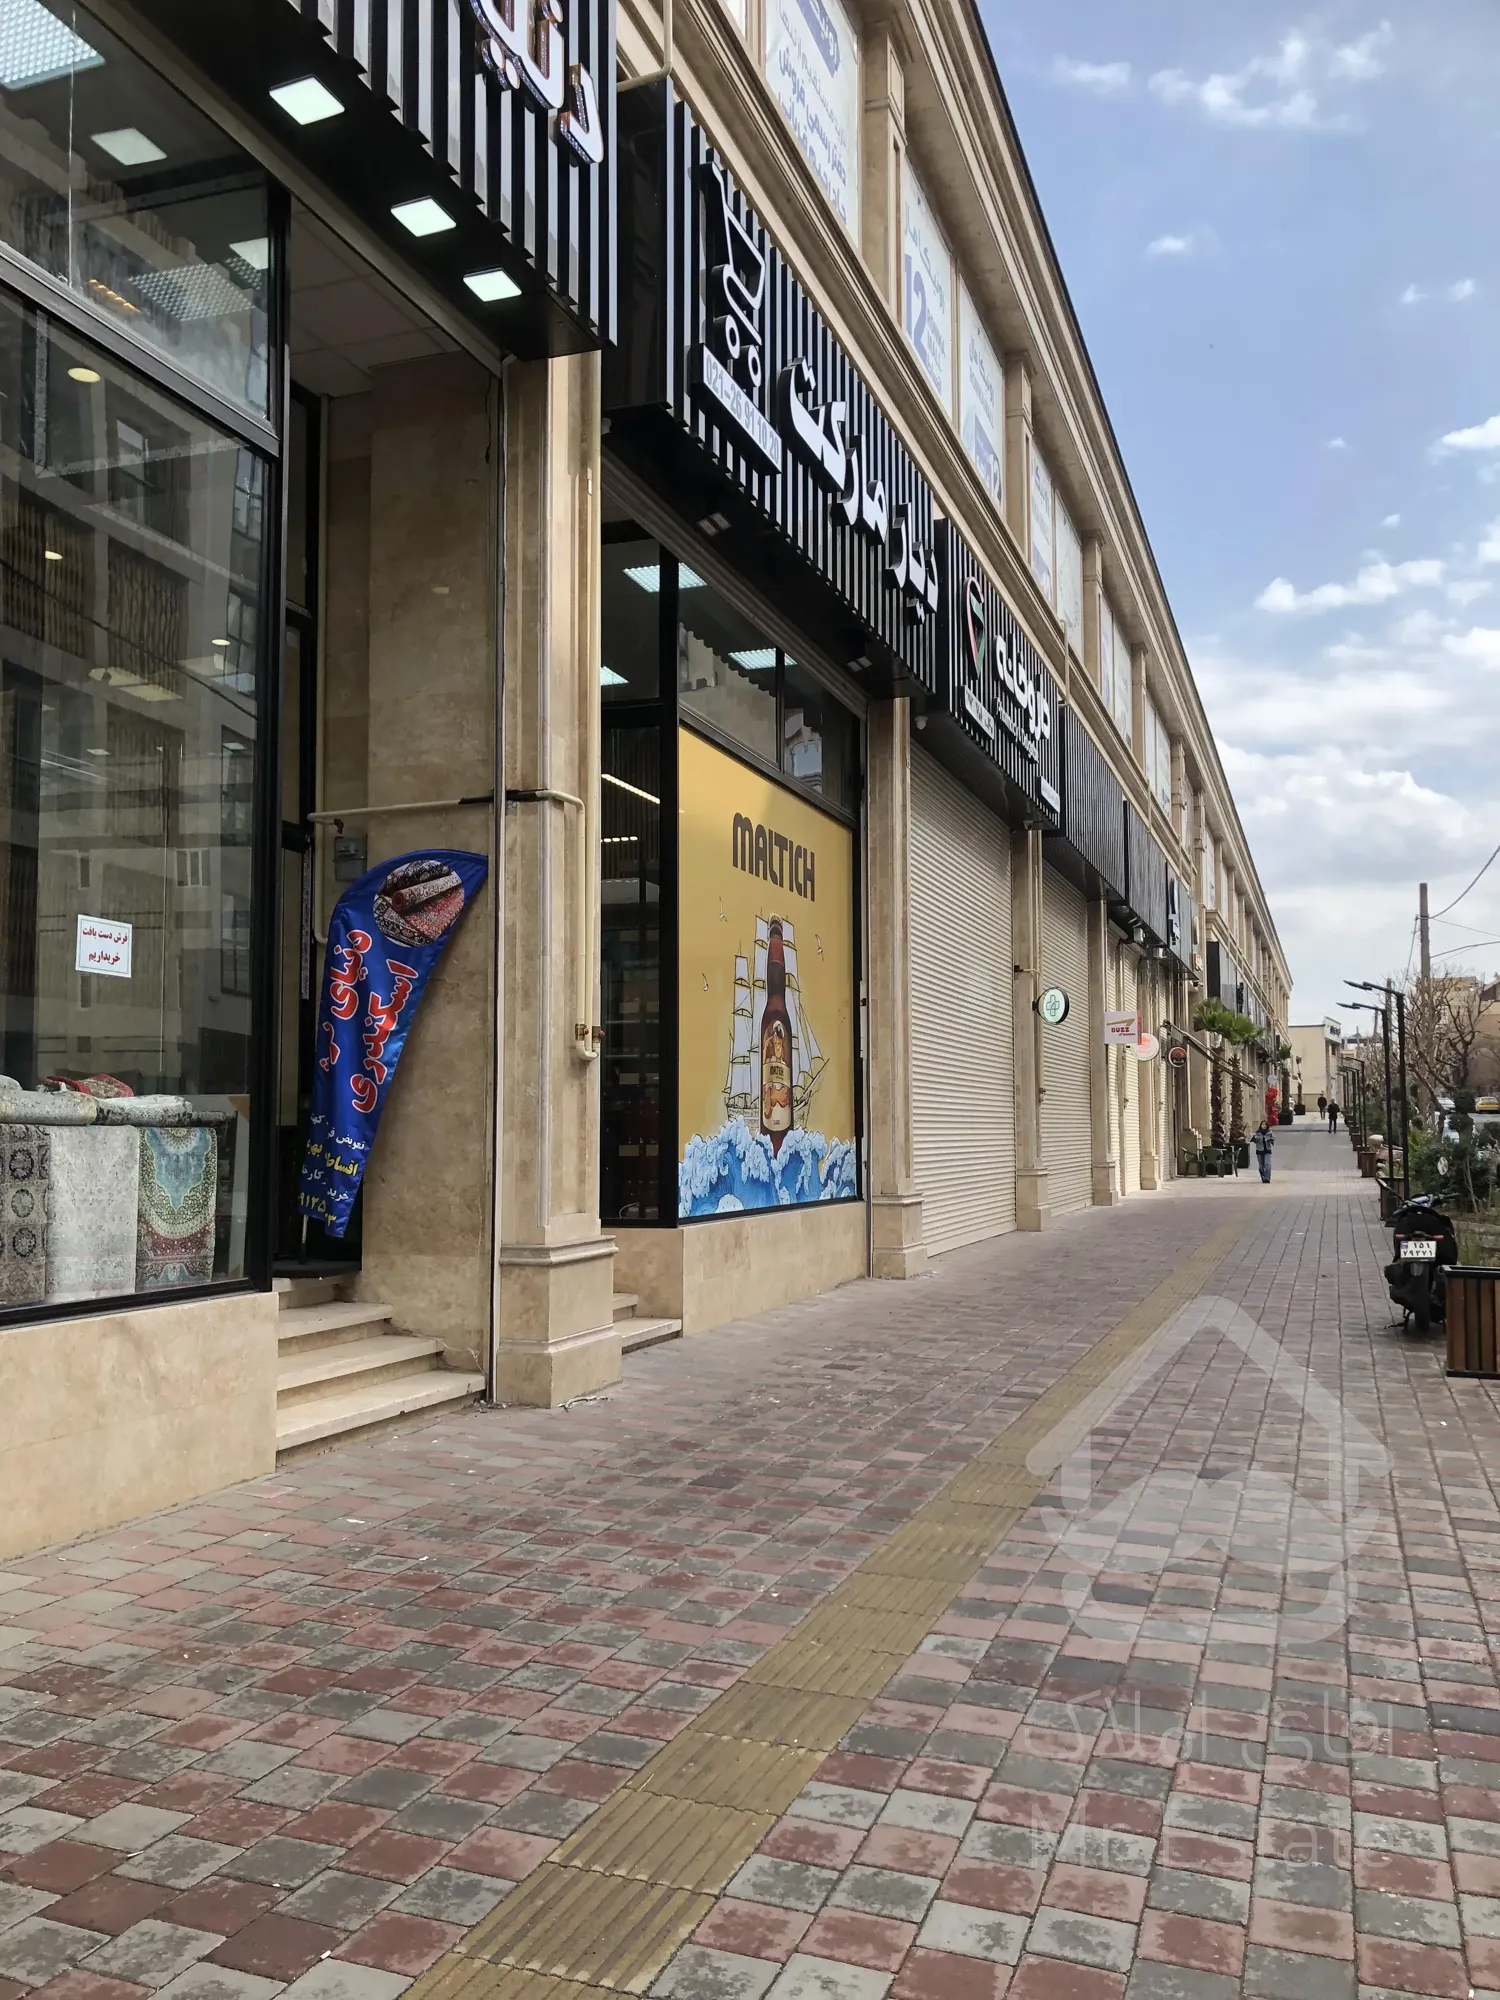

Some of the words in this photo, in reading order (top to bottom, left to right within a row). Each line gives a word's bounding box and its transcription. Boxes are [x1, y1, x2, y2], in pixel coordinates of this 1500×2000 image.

[778, 46, 806, 109] فروش
[832, 143, 847, 187] دفتر
[706, 354, 742, 420] 021-26
[744, 400, 756, 437] 91
[757, 415, 768, 450] 10
[769, 432, 780, 465] 20
[789, 356, 889, 546] مارکت
[995, 633, 1050, 741] داروخانه
[732, 812, 815, 902] MALTICH
[82, 926, 97, 939] بافت
[98, 930, 113, 939] دست
[113, 932, 128, 944] فرش
[88, 950, 121, 965] خریداریم
[329, 929, 373, 1020] دنیای
[350, 958, 419, 1113] اسکندری
[325, 1152, 359, 1176] اقساط
[336, 1134, 365, 1150] تعویض
[326, 1187, 350, 1202] خرید
